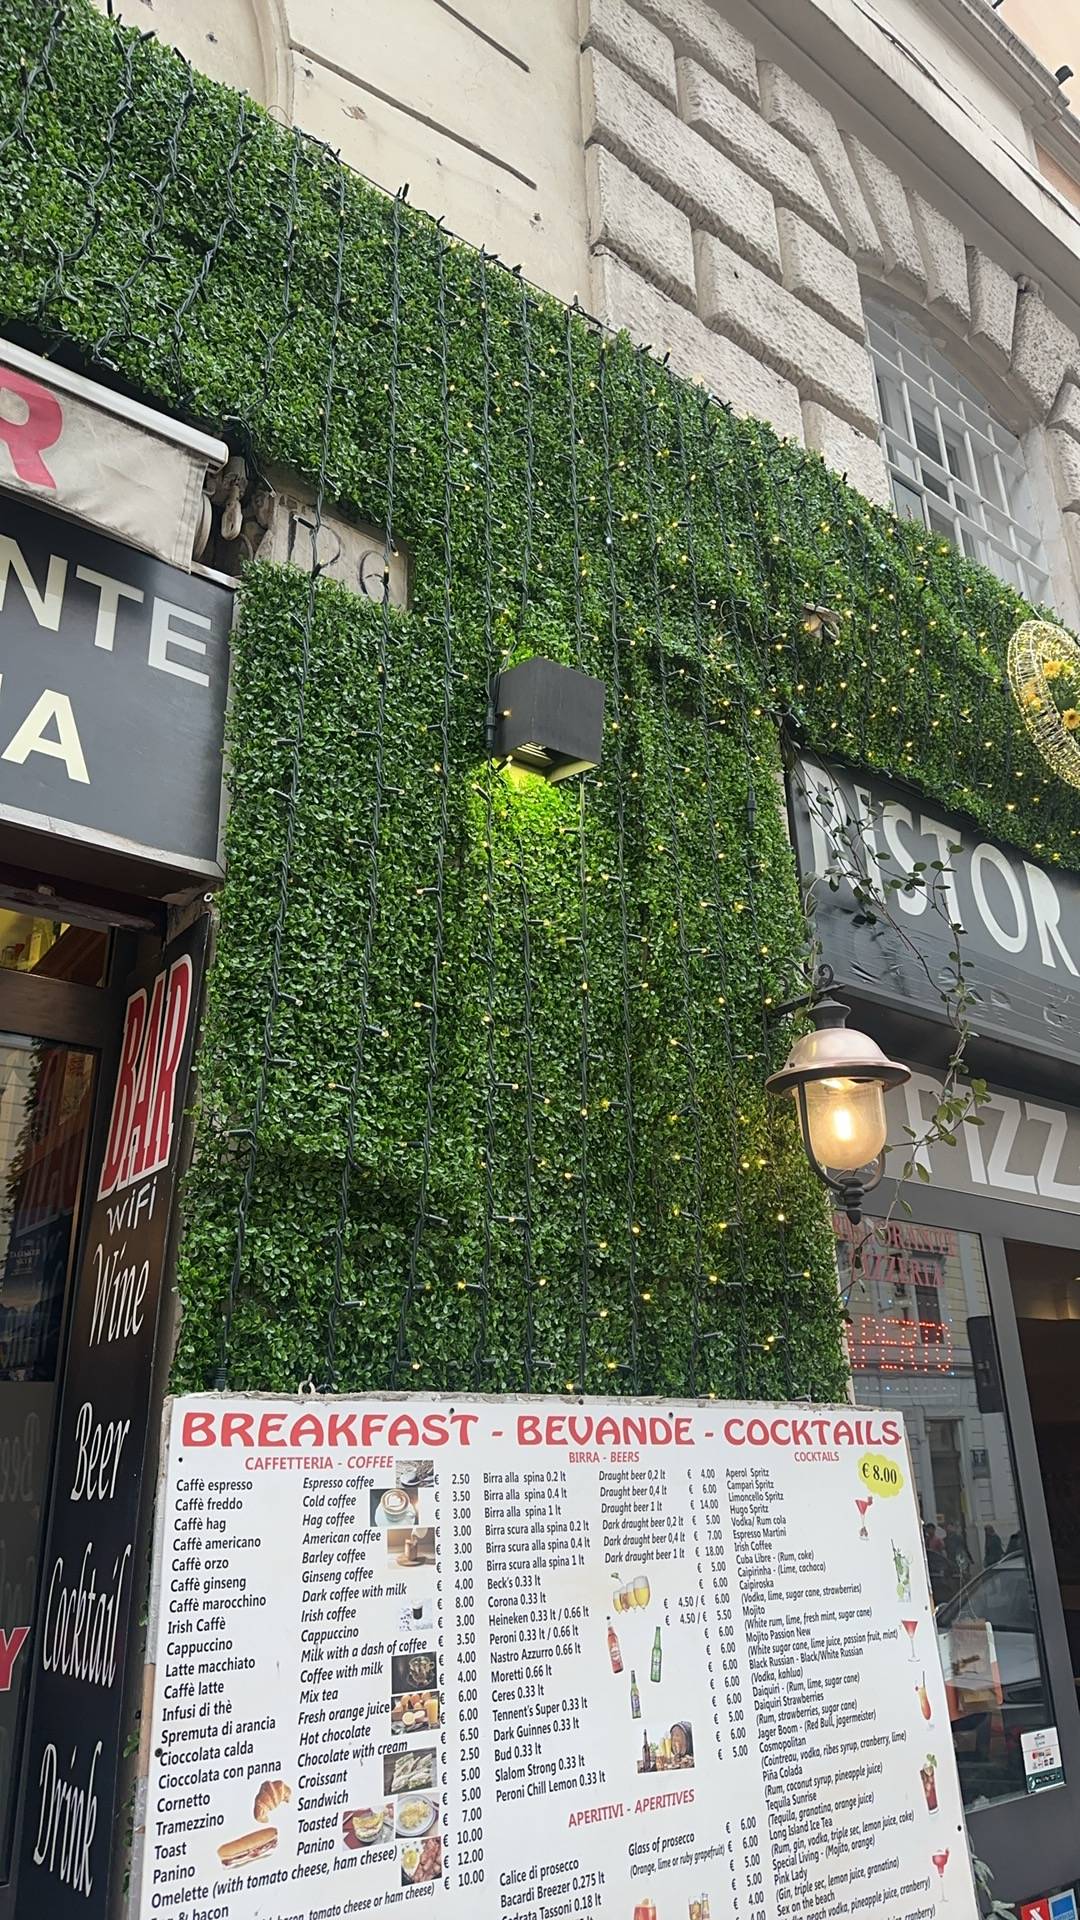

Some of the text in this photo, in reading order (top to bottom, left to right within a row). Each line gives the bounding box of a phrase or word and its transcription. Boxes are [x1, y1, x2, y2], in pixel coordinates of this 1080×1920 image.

[98, 953, 192, 1201] BAR
[88, 1240, 149, 1347] Wine
[182, 1412, 479, 1447] BREAKFAST
[517, 1415, 695, 1446] BEVANDE
[724, 1418, 901, 1446] COCKTAILS
[71, 1402, 131, 1501] Beer
[569, 1451, 600, 1463] BIRRA
[610, 1451, 640, 1463] BEERS
[794, 1451, 839, 1462] COCKTAILS
[245, 1456, 333, 1470] CAFFETTERIA
[347, 1456, 394, 1469] COFFEE
[452, 1473, 470, 1485] 2.50
[483, 1471, 566, 1485] Birra alla spina 0.2 lt
[599, 1469, 666, 1484] Draught beer 0,2 lt
[701, 1468, 715, 1479] 4.00
[726, 1467, 770, 1480] Aperol Spritz
[873, 1464, 897, 1484] 8.00
[176, 1478, 253, 1494] Caffè espresso
[303, 1475, 374, 1492] Espresso coffee
[727, 1479, 774, 1491] Campari Spritz
[175, 1497, 243, 1511] Caffè freddo
[303, 1494, 357, 1509] Cold coffee
[728, 1491, 784, 1503] Limoncello Spritz
[729, 1503, 769, 1516] Hugo Spritz
[174, 1517, 226, 1533] Caffè hag
[302, 1512, 355, 1529] Hag coffee
[173, 1536, 261, 1551] Caffè americano
[302, 1529, 381, 1545] American coffee
[734, 1540, 772, 1552] Irish Coffee
[172, 1557, 229, 1572] Caffè orzo
[170, 1576, 246, 1594] Caffè ginseng
[487, 1574, 541, 1590] Beck's 0.33 lt
[739, 1578, 774, 1591] Caipiroska
[169, 1594, 266, 1613] Caffè marocchino
[455, 1595, 474, 1608] 8.00
[488, 1591, 546, 1608] Corona 0.33 lt
[43, 1542, 131, 1688] Cocktail
[742, 1604, 765, 1617] Mojito
[168, 1616, 226, 1634] Irish Caffè
[167, 1637, 233, 1658] Cappuccino
[166, 1657, 255, 1677] Latte macchiato
[491, 1664, 552, 1683] Moretti 0.66 lt
[164, 1681, 224, 1699] Caffè latte
[492, 1684, 544, 1702] Ceres 0.33 lt
[162, 1700, 232, 1722] Infusi di thè
[298, 1701, 390, 1725] Fresh orange juice
[161, 1719, 276, 1746] Spremuta di arancia
[299, 1725, 371, 1746] Hot chocolate
[160, 1741, 253, 1767] Cioccolata calda
[297, 1741, 408, 1768] Chocolate with cream
[158, 1761, 281, 1789] Cioccolata con panna
[298, 1769, 348, 1789] Croissant
[762, 1765, 803, 1782] Piña Colada
[157, 1793, 210, 1813] Cornetto
[297, 1789, 349, 1811] Sandwich
[568, 1803, 624, 1828] APERITIVI
[634, 1789, 695, 1814] APERITIVES
[33, 1740, 103, 1897] Drink
[155, 1814, 224, 1836] Tramezzino
[298, 1812, 339, 1833] Toasted
[769, 1817, 833, 1841] Long Island Ice Tea
[154, 1842, 187, 1860] Toast
[297, 1837, 335, 1856] Panino
[628, 1833, 695, 1856] Glass of prosecco
[458, 1849, 484, 1866] 12.00
[151, 1846, 397, 1909] Omelette (with tomato cheese, ham chesee)
[153, 1864, 195, 1884] Panino
[499, 1859, 579, 1886] Calice di prosecco
[774, 1868, 807, 1886] Pink Lady
